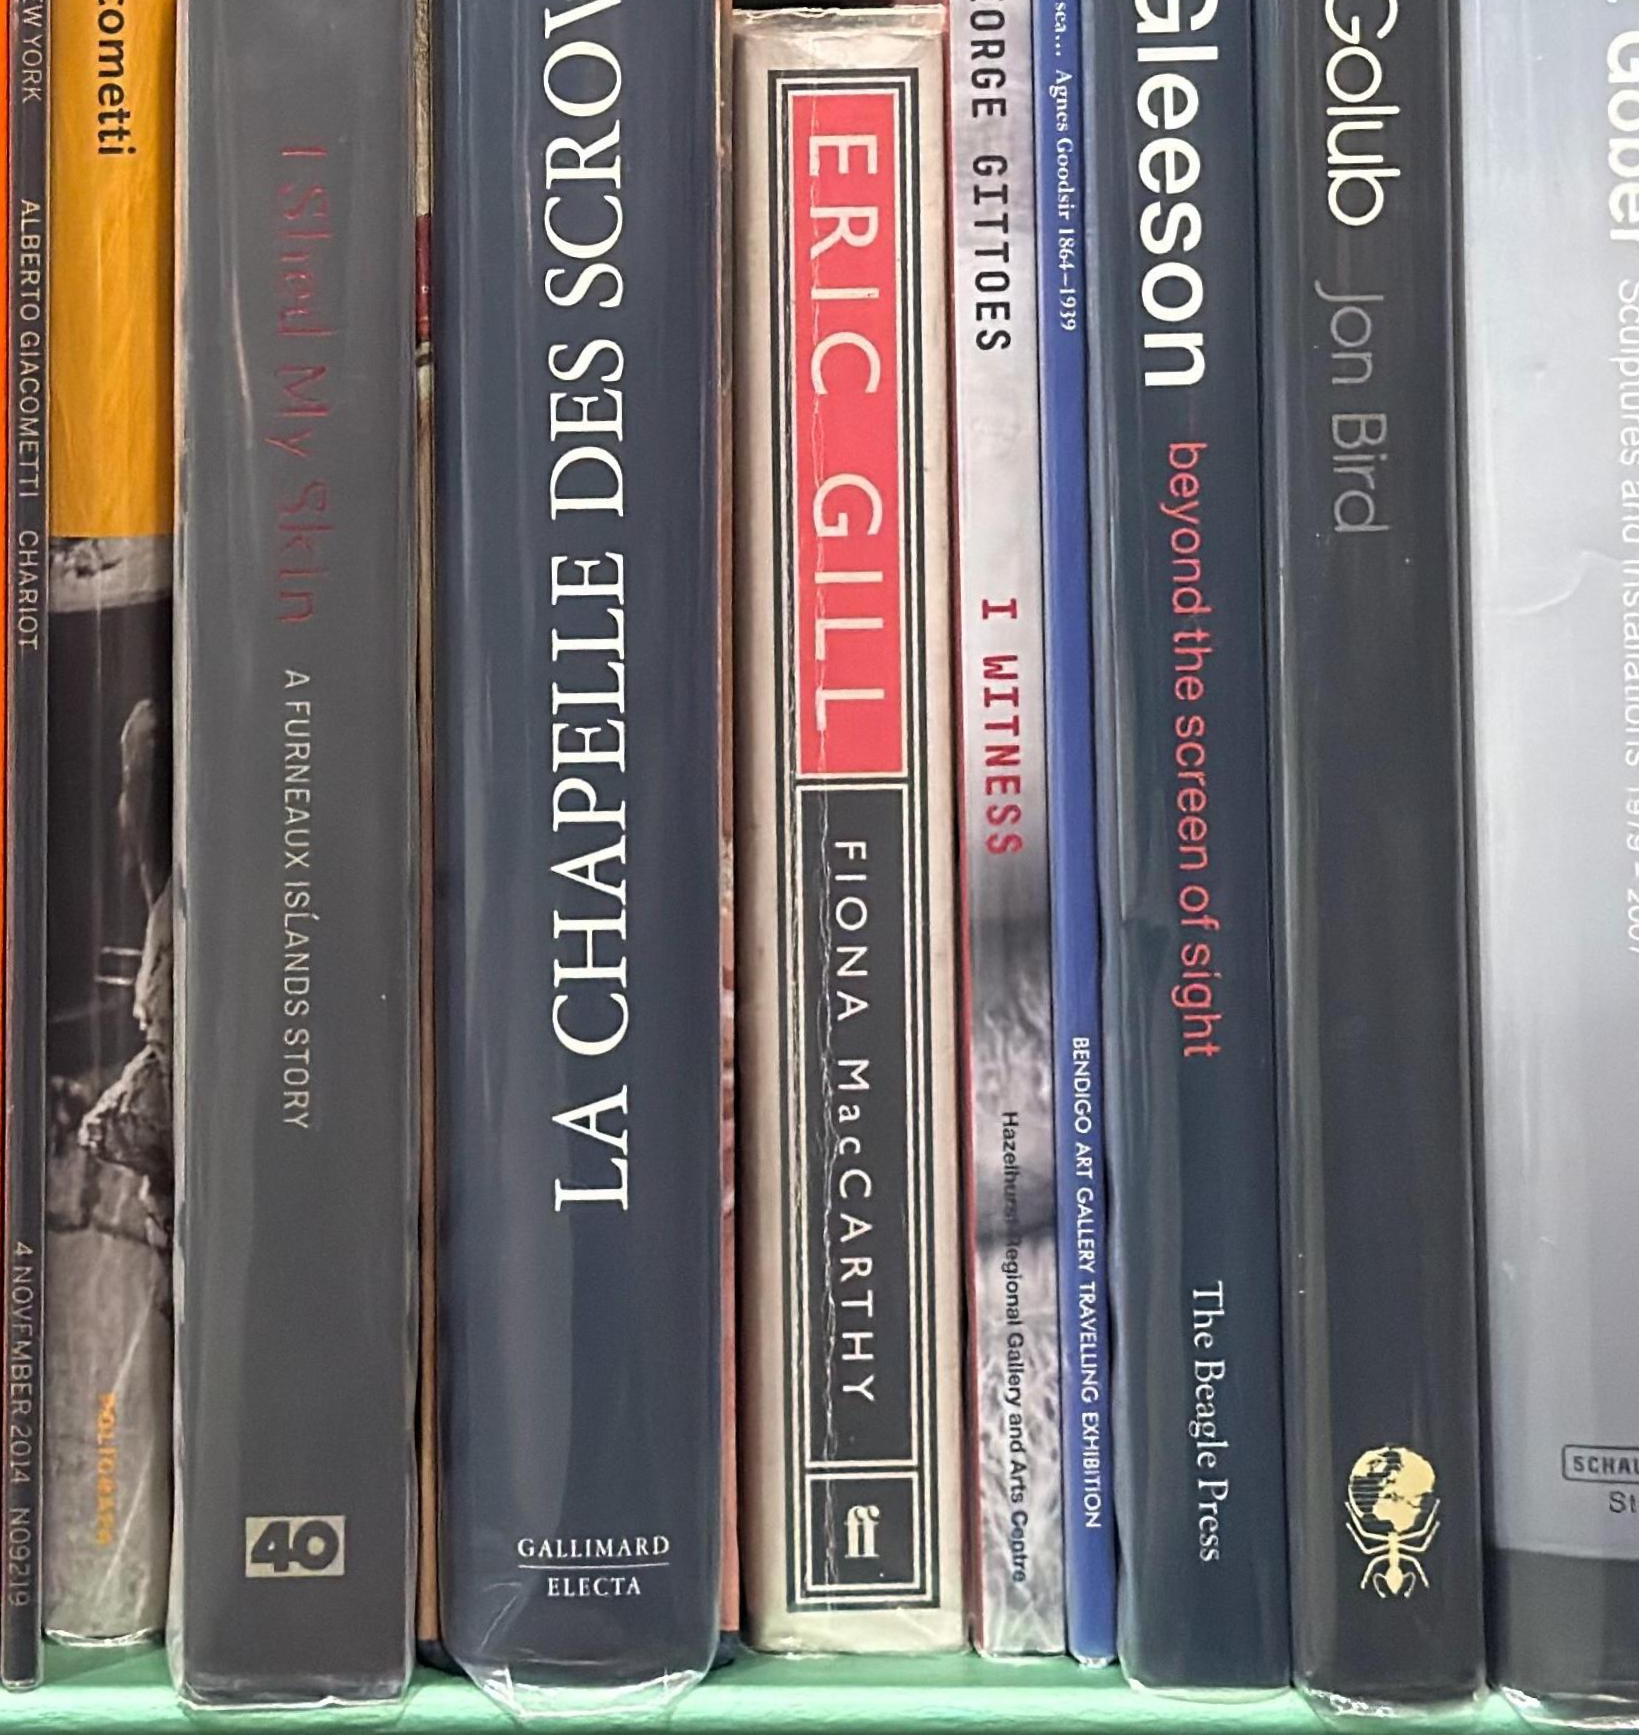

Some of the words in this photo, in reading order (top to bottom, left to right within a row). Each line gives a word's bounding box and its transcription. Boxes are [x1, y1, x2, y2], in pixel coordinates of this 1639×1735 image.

[23, 36, 41, 102] YORK
[1049, 69, 1076, 131] Agnes
[283, 145, 328, 157] I
[1054, 137, 1077, 220] Goodsir
[18, 198, 41, 320] ALBERTO
[278, 183, 333, 337] Shed
[808, 133, 881, 396] ERIC
[971, 154, 1011, 352] GITTOES
[1313, 280, 1386, 385] Jon
[17, 331, 40, 497] GIACOMETTI
[266, 365, 328, 459] My
[548, 339, 626, 520] DES
[1331, 413, 1390, 532] Bird
[278, 480, 334, 623] Skin
[1159, 441, 1217, 619] beyond
[17, 530, 38, 651] CHARIOT
[812, 471, 884, 733] GILL
[981, 598, 1018, 620] I
[284, 669, 310, 688] A
[1174, 629, 1214, 703] the
[283, 700, 310, 869] FURNEAUX
[550, 554, 630, 1057] CHAPELLE
[981, 656, 1022, 856] WITNESS
[1176, 714, 1211, 870] screen
[282, 881, 310, 1017] ISLANDS
[832, 841, 870, 1022] FIONA
[1180, 884, 1219, 933] of
[1174, 942, 1223, 1057] sight
[283, 1028, 309, 1129] STORY
[1071, 1036, 1093, 1133] BENDIGO
[552, 1086, 630, 1212] LA
[1074, 1141, 1095, 1180] ART
[12, 1241, 33, 1256] 4
[836, 1059, 876, 1404] MacCARTHY
[1001, 1230, 1026, 1327] Regional
[1074, 1187, 1097, 1273] GALLERY
[9, 1266, 33, 1415] NOVEMBER
[1076, 1281, 1101, 1403] TRAVELLING
[1192, 1280, 1226, 1348] The
[1003, 1332, 1028, 1408] Gallery
[1188, 1360, 1226, 1468] Beagle
[10, 1424, 31, 1484] 2014
[1008, 1414, 1030, 1453] and
[1009, 1460, 1031, 1503] Arts
[1080, 1411, 1104, 1529] EXHIBITION
[517, 1537, 671, 1557] GALLIMARD
[1009, 1510, 1033, 1582] Centre
[1195, 1479, 1228, 1561] Press
[547, 1578, 641, 1596] ELECTA
